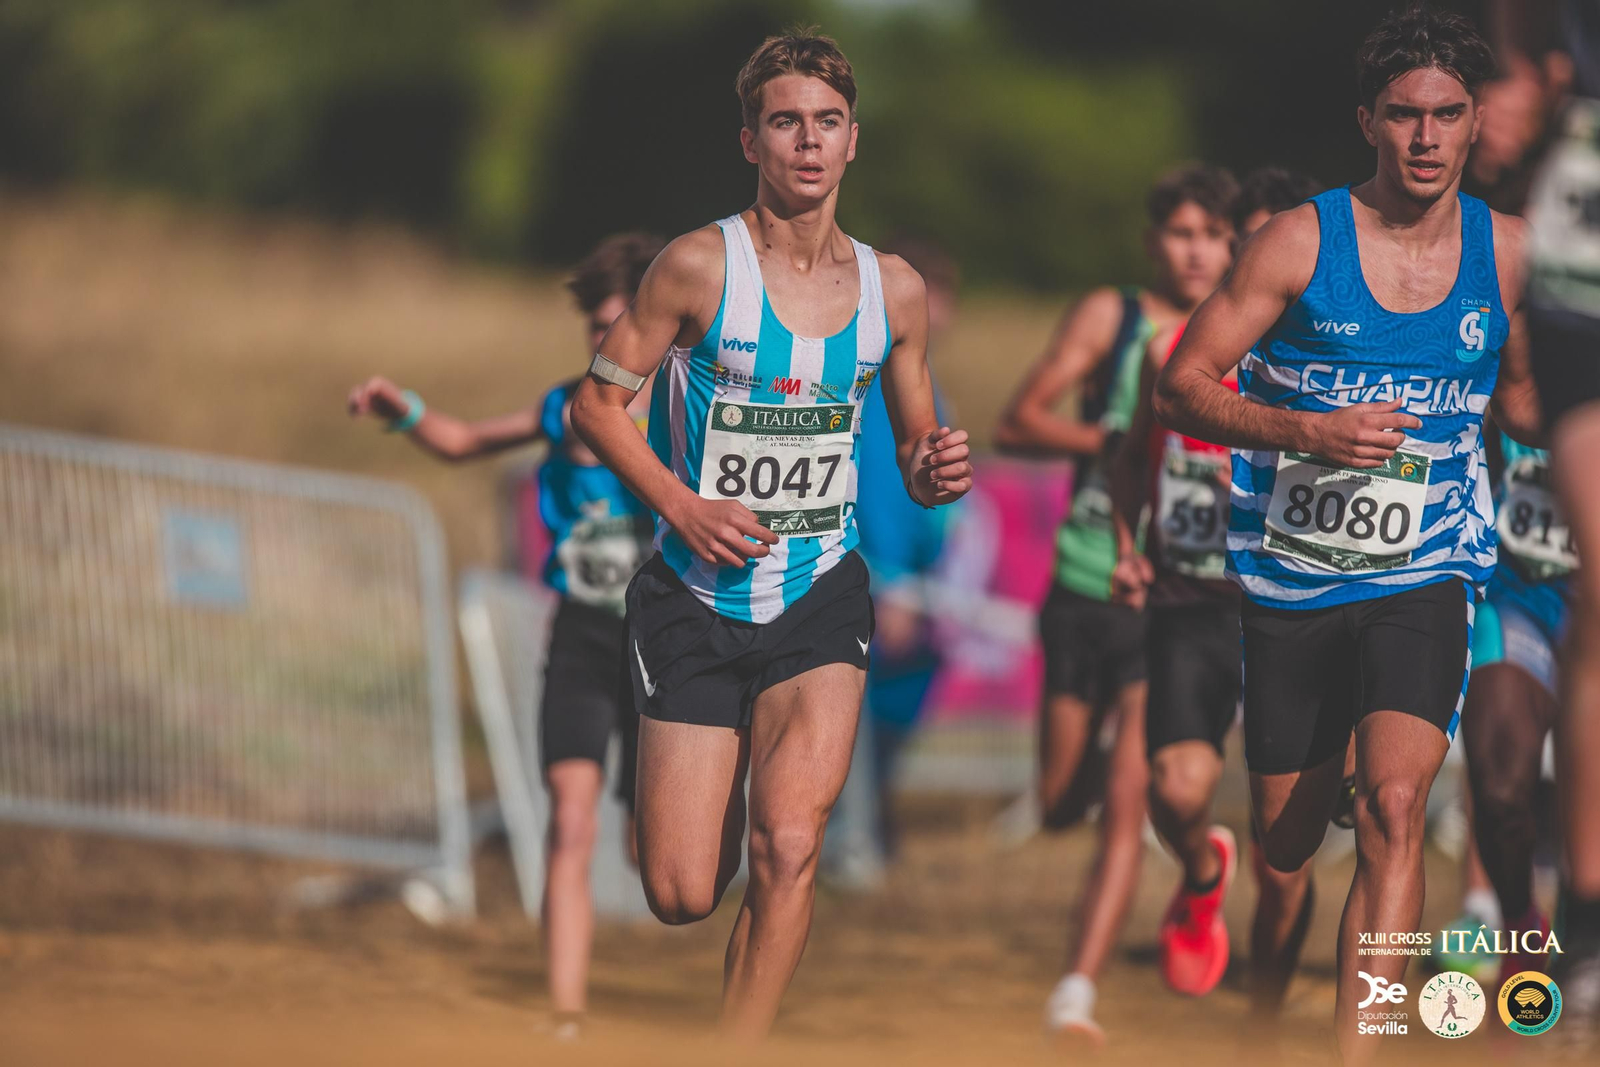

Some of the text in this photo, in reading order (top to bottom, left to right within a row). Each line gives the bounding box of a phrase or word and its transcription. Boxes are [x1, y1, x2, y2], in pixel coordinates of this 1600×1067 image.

[1461, 298, 1491, 308] CHAPIN
[1313, 319, 1361, 336] vive
[722, 338, 757, 353] vive
[811, 382, 839, 391] metro
[1301, 363, 1474, 414] CHAPIN
[752, 408, 822, 426] ITÁLICA
[716, 453, 842, 500] 8047
[1166, 499, 1230, 541] 59
[1282, 484, 1411, 546] 8080
